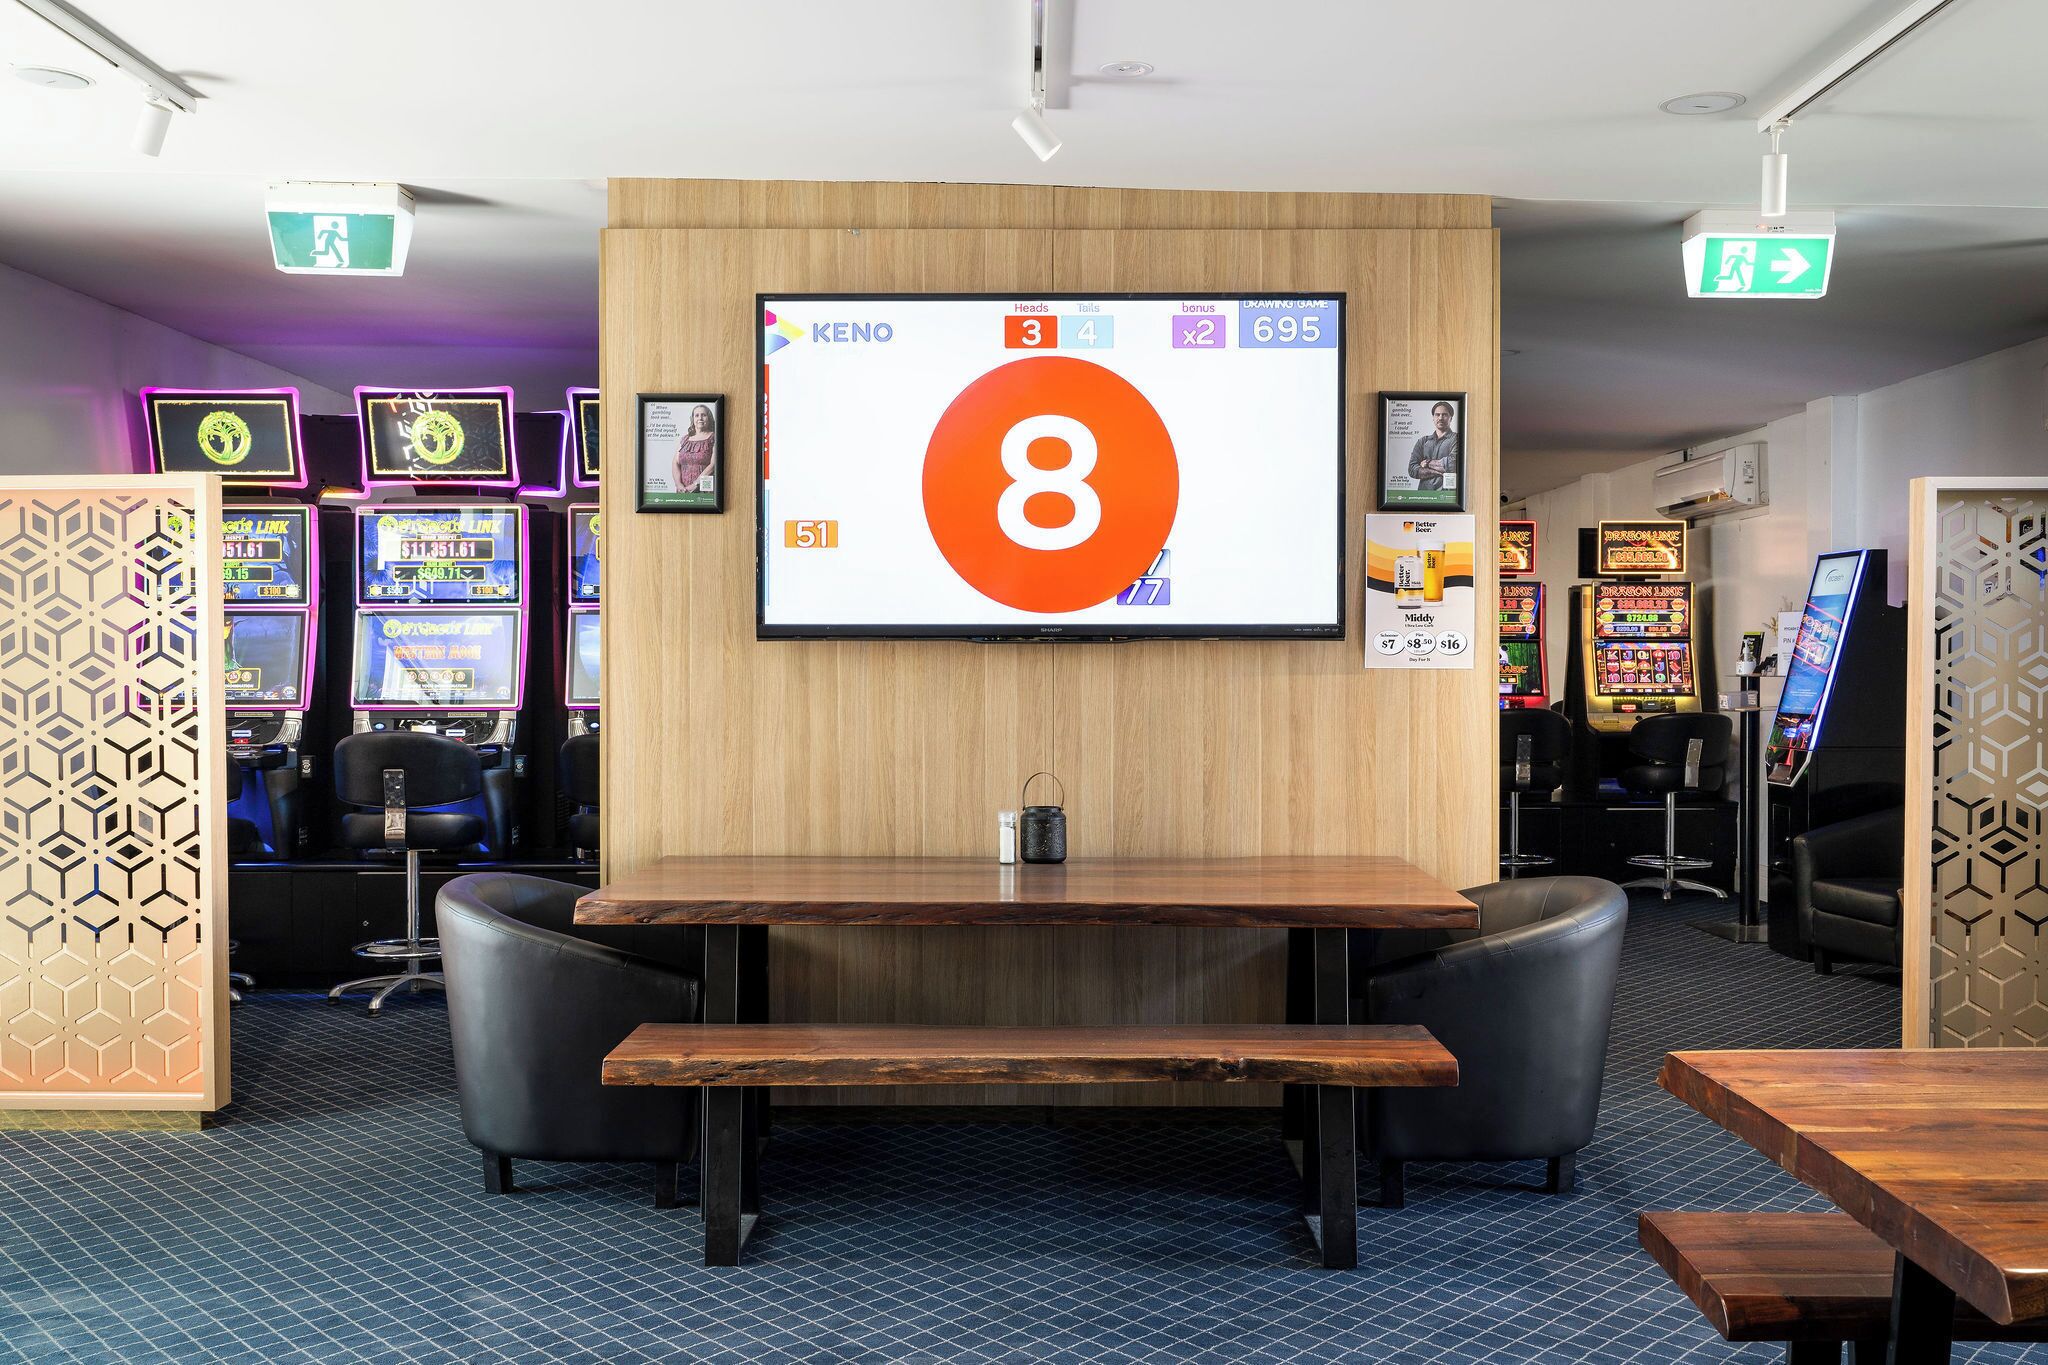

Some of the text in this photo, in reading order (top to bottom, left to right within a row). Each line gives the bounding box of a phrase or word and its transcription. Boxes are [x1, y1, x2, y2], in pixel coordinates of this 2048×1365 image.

[1014, 303, 1049, 313] Heads
[1077, 303, 1100, 313] Tails
[1182, 302, 1215, 313] bonus
[1243, 300, 1328, 309] DRAWING GAME
[813, 322, 893, 343] KENO
[1021, 319, 1042, 346] 3
[1077, 319, 1098, 346] 4
[1183, 319, 1216, 346] x2
[1253, 315, 1321, 343] 695
[997, 414, 1101, 550] 8
[255, 520, 290, 534] LINK
[467, 519, 501, 534] LINK
[795, 520, 829, 548] 51
[1604, 530, 1652, 541] DRAGON
[1601, 586, 1652, 597] DRAGON
[1404, 613, 1435, 624] Middy
[1382, 639, 1395, 649] $7
[1440, 639, 1460, 649] $16
